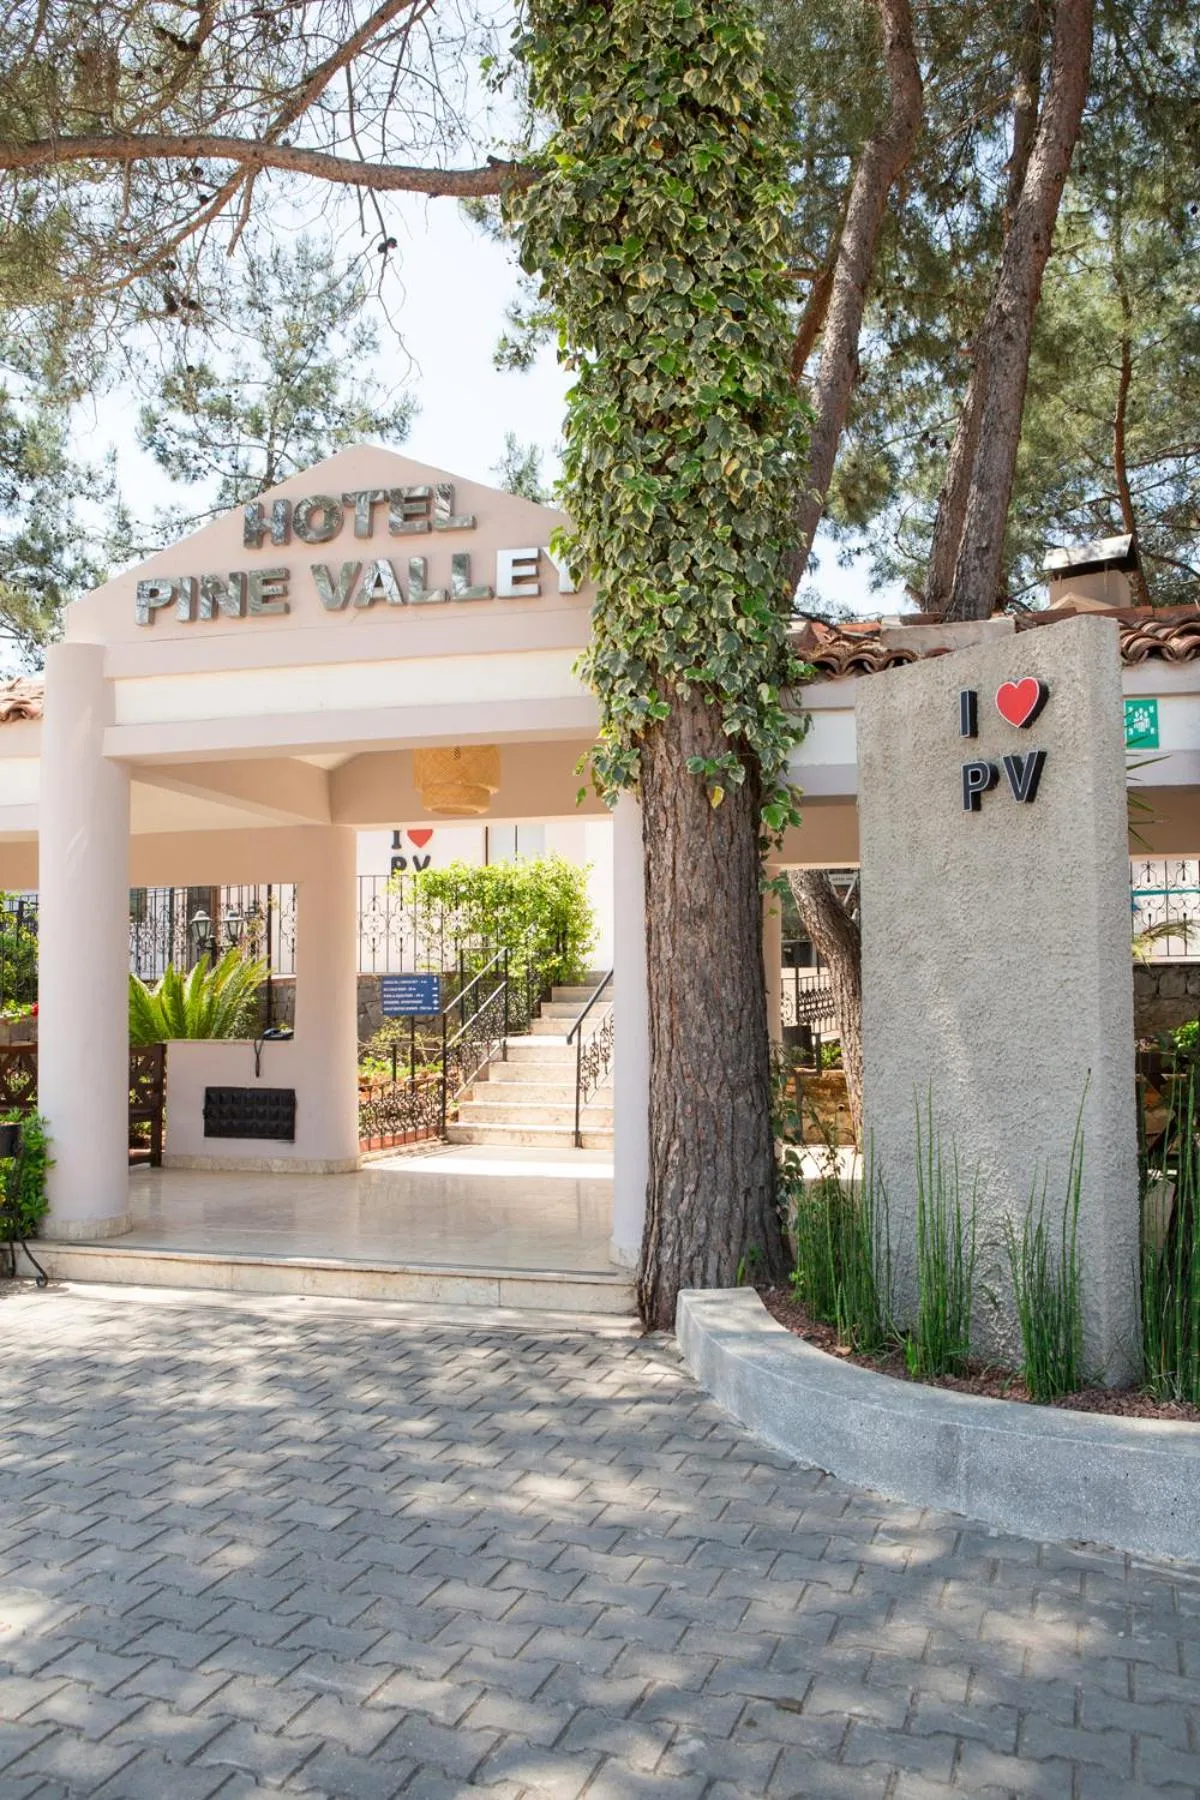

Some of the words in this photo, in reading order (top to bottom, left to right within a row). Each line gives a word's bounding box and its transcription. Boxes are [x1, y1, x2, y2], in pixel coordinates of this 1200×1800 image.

[243, 484, 477, 549] HOTEL
[135, 568, 291, 626] PINE
[960, 690, 978, 738] I
[961, 751, 1047, 812] PV
[391, 830, 402, 849] I
[391, 855, 431, 878] PV
